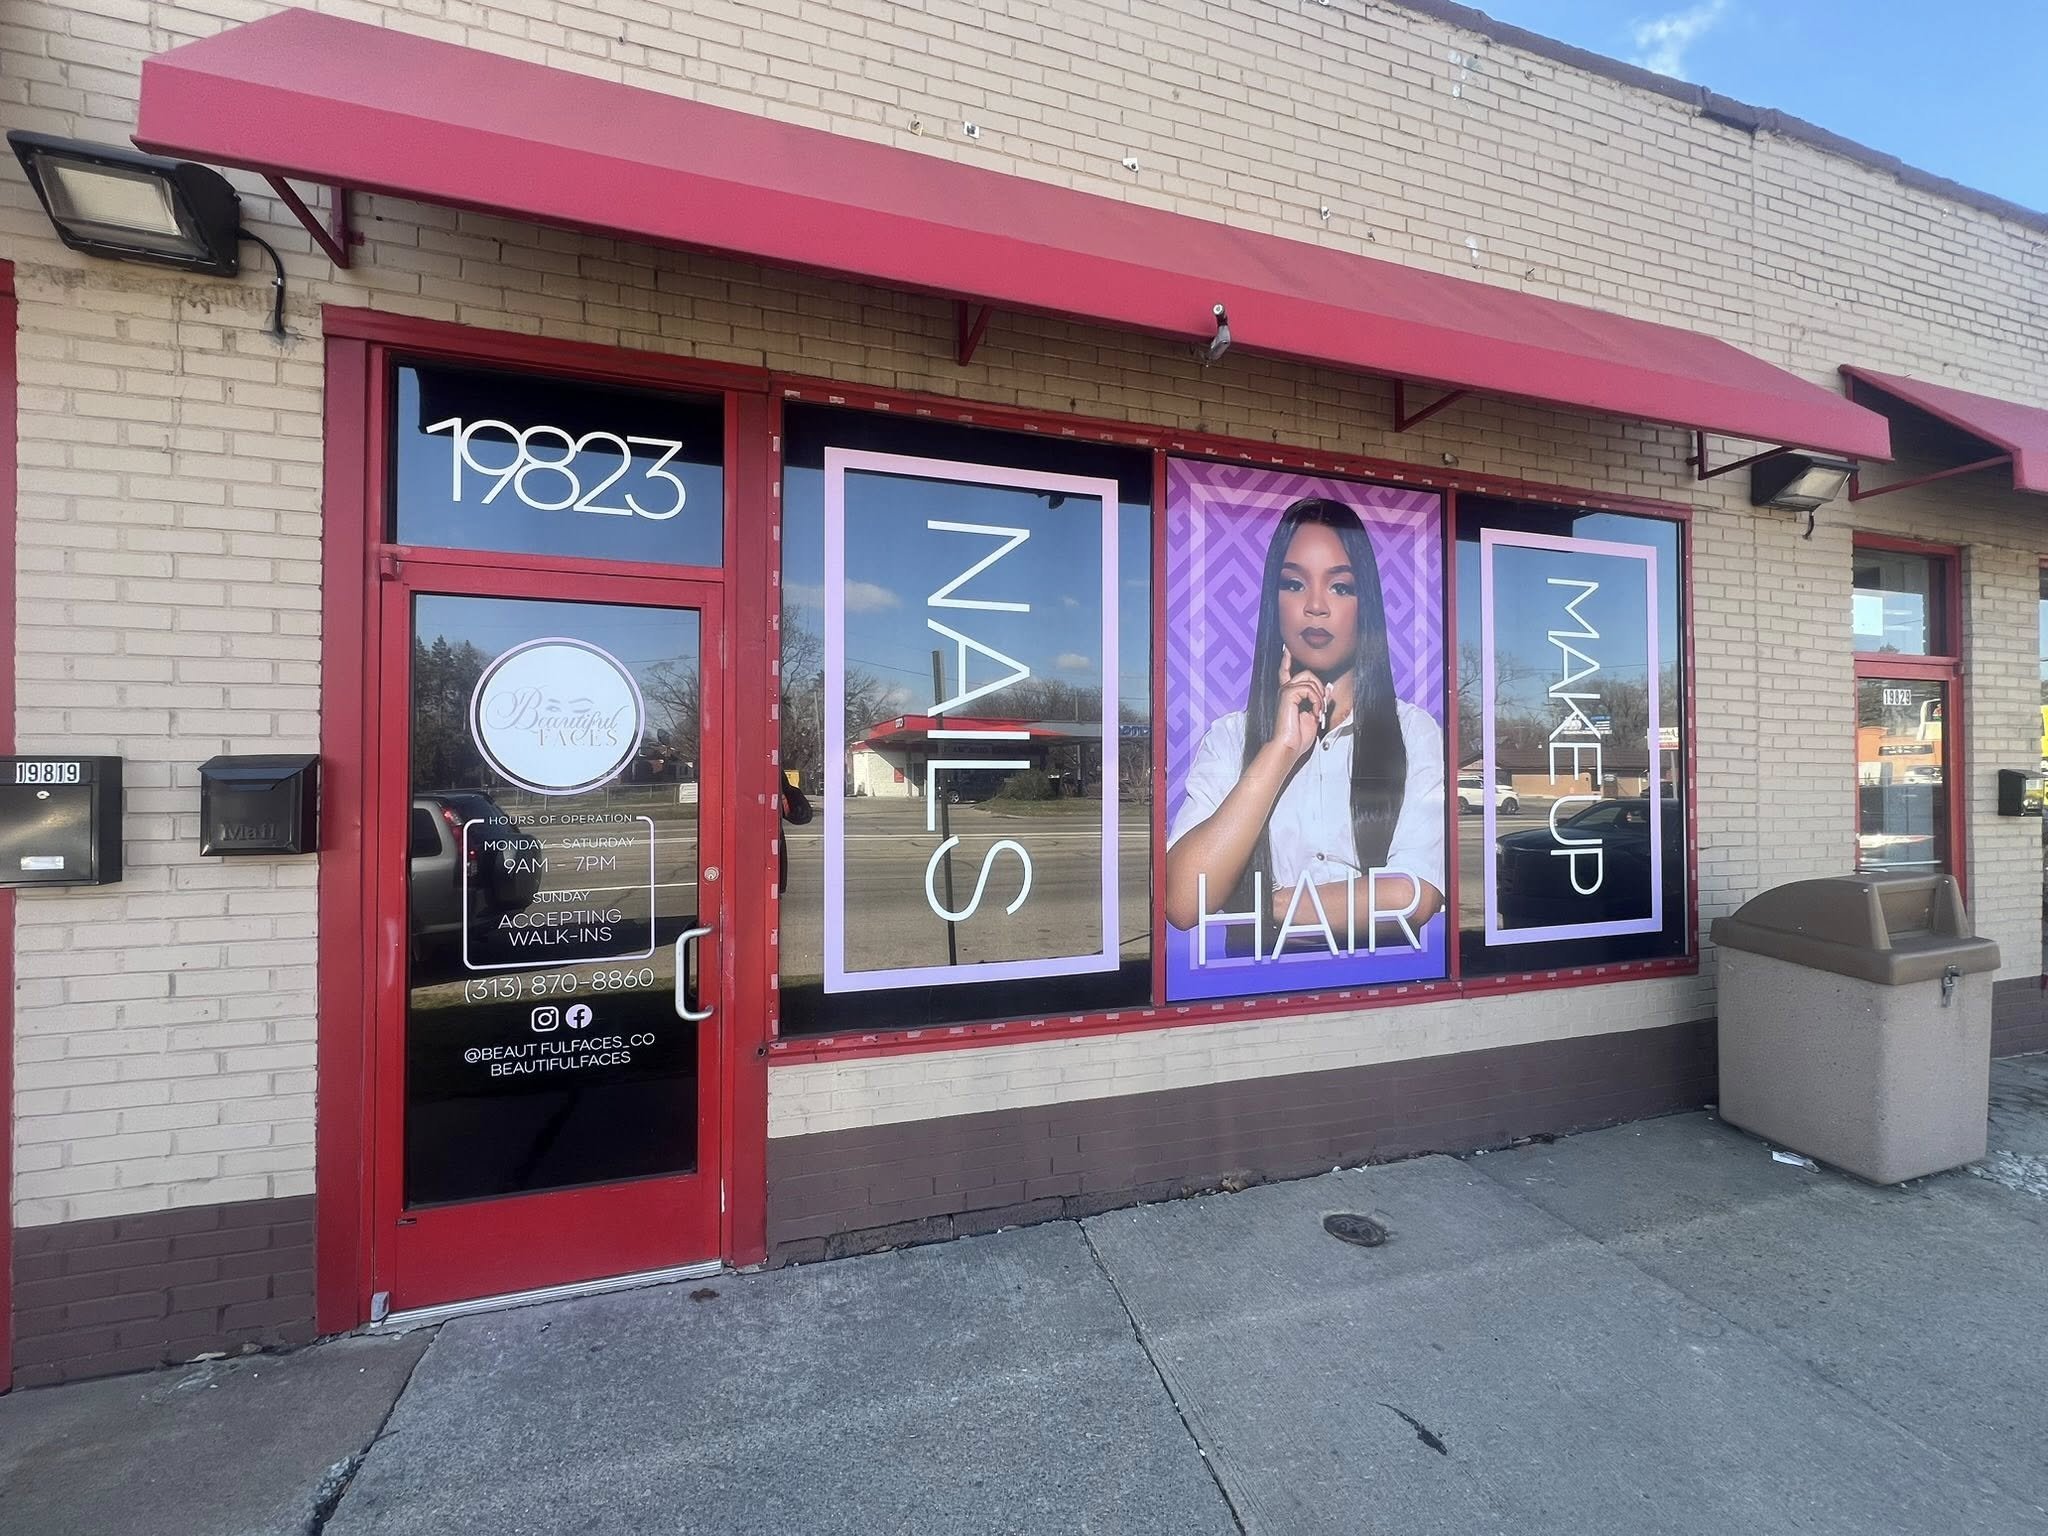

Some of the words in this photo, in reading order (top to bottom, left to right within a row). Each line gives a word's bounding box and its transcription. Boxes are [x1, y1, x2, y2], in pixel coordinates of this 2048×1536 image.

[426, 417, 687, 520] 19823
[1546, 577, 1602, 786] MAKE
[486, 686, 630, 738] Beautiful
[925, 519, 1033, 922] NAILS
[534, 729, 619, 747] FACES
[16, 763, 79, 784] 19819
[489, 815, 535, 826] HOURS
[539, 814, 557, 825] OF
[560, 813, 632, 825] OPERATION
[220, 821, 279, 841] Mail
[484, 839, 547, 851] MONDAY
[562, 837, 635, 849] SATURDAY
[1548, 795, 1603, 896] UP
[503, 857, 549, 874] 9AM
[573, 855, 617, 872] 7PM
[532, 890, 590, 904] SUNDAY
[498, 908, 622, 930] ACCEPTING
[1198, 866, 1422, 966] HAIR
[508, 926, 613, 947] WALK-INS
[464, 976, 523, 1004] (313)
[531, 967, 655, 996] 870-8860
[490, 1050, 632, 1077] BEAUTIFULFACES
